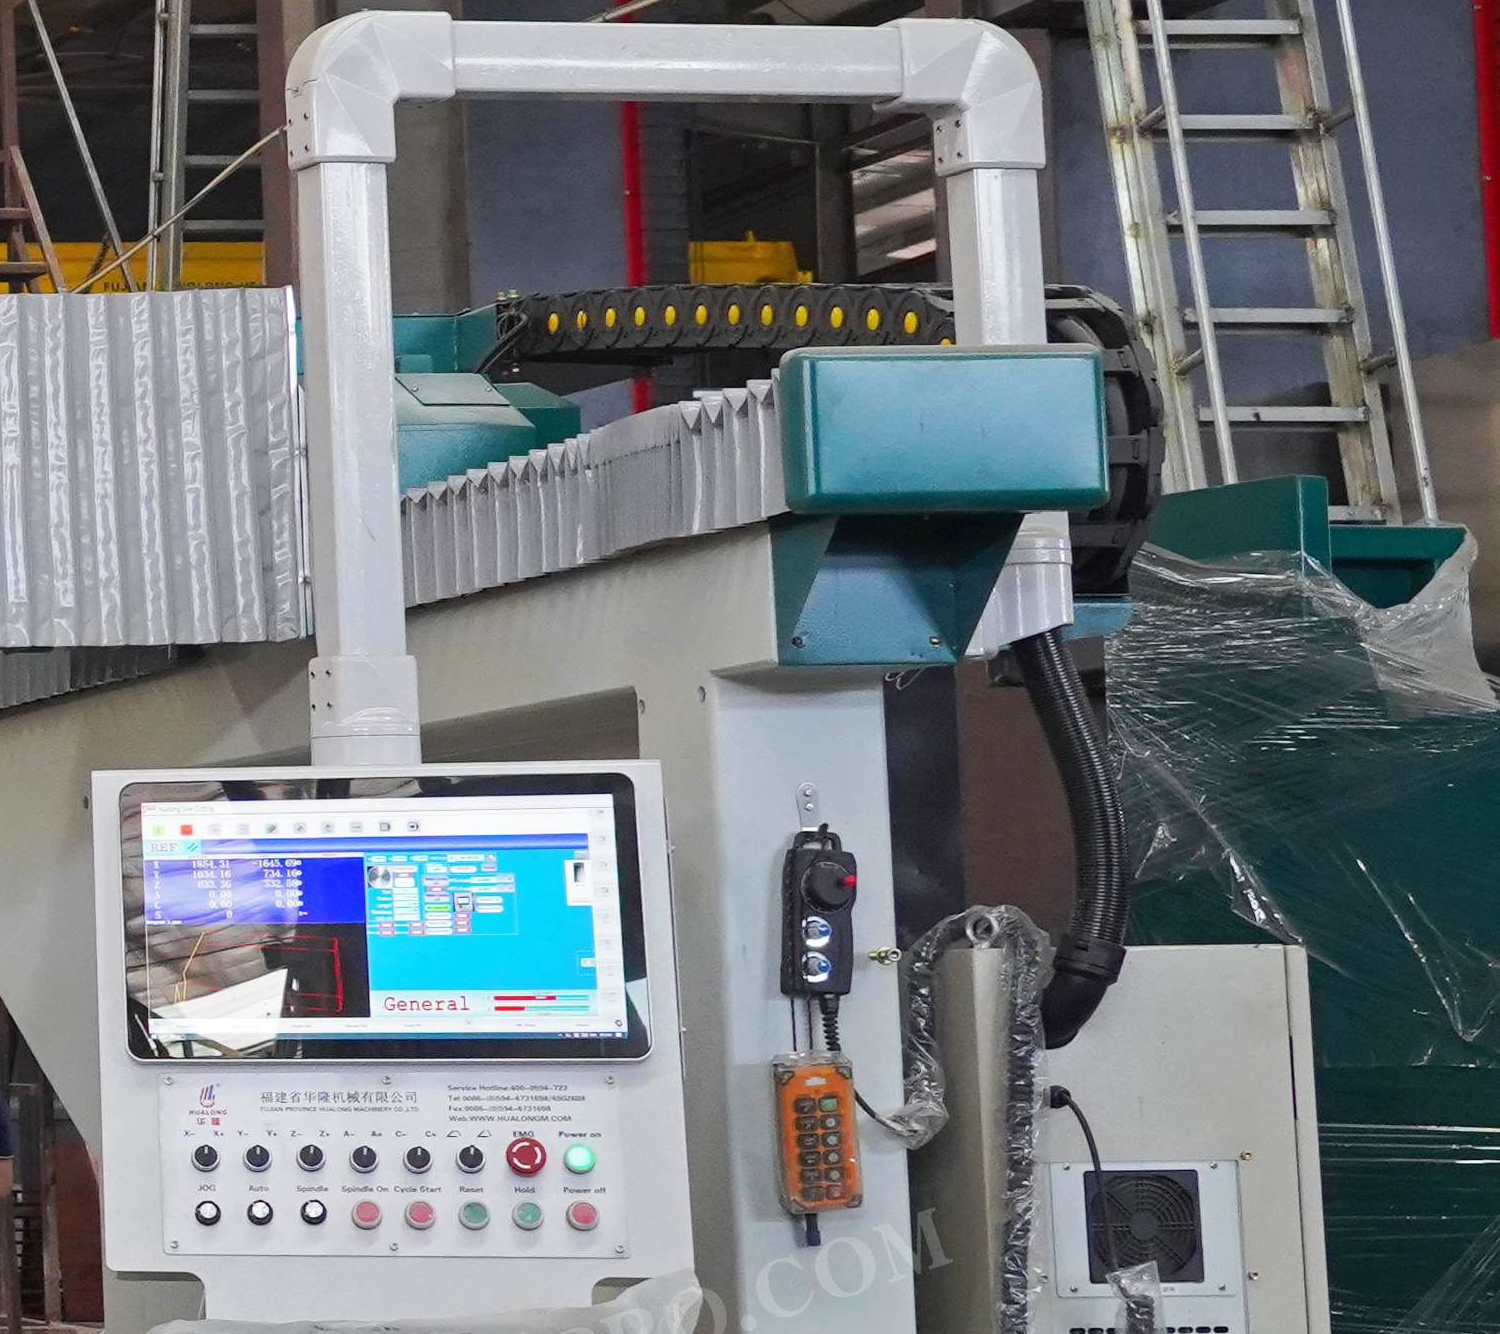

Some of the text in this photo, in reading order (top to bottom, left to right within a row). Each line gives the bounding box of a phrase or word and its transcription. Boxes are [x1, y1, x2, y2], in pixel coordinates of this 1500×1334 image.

[150, 842, 179, 852] REF
[383, 995, 470, 1012] General
[447, 1084, 477, 1092] Service
[260, 1090, 418, 1105] 福建省华隆机械有限公司
[513, 1130, 535, 1138] EMG
[197, 1184, 217, 1192] JOG
[296, 1185, 329, 1194] Spindle
[341, 1185, 374, 1194] Spindle
[393, 1185, 417, 1194] Cycle
[514, 1186, 536, 1194] Hold
[563, 1186, 592, 1194] Power
